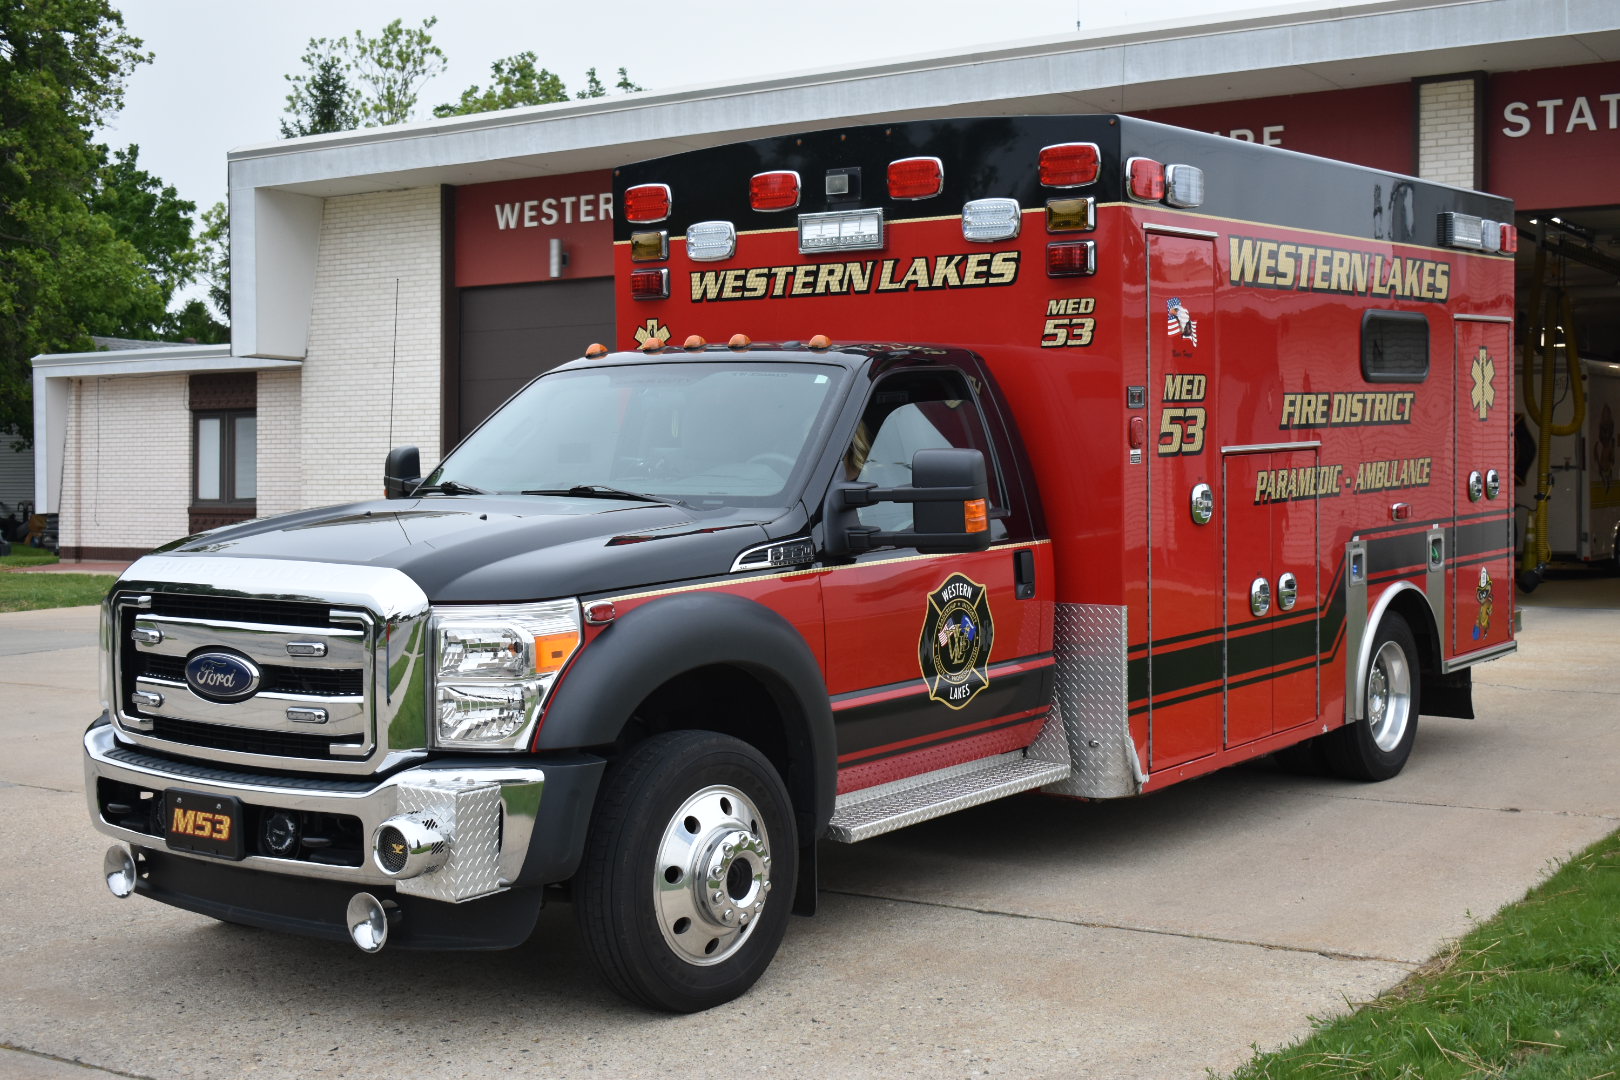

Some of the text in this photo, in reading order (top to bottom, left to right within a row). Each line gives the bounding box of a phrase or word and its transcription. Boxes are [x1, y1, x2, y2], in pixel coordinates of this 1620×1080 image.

[1502, 93, 1620, 138] STAT
[494, 192, 614, 230] WESTER
[690, 250, 1020, 303] WESTERN LAKES
[1229, 235, 1450, 302] WESTERN LAKES
[1046, 297, 1096, 317] MED
[1041, 317, 1096, 348] 53
[1162, 373, 1206, 403] MED
[1280, 391, 1415, 429] FIRE DISTRICT
[1158, 407, 1206, 457] 53
[1254, 465, 1342, 505] PARAMEDIC
[1354, 457, 1432, 495] AMBULANCE
[941, 582, 973, 602] WESTERN
[196, 660, 236, 688] Ford
[949, 683, 971, 700] LAKES
[172, 807, 231, 841] M53
